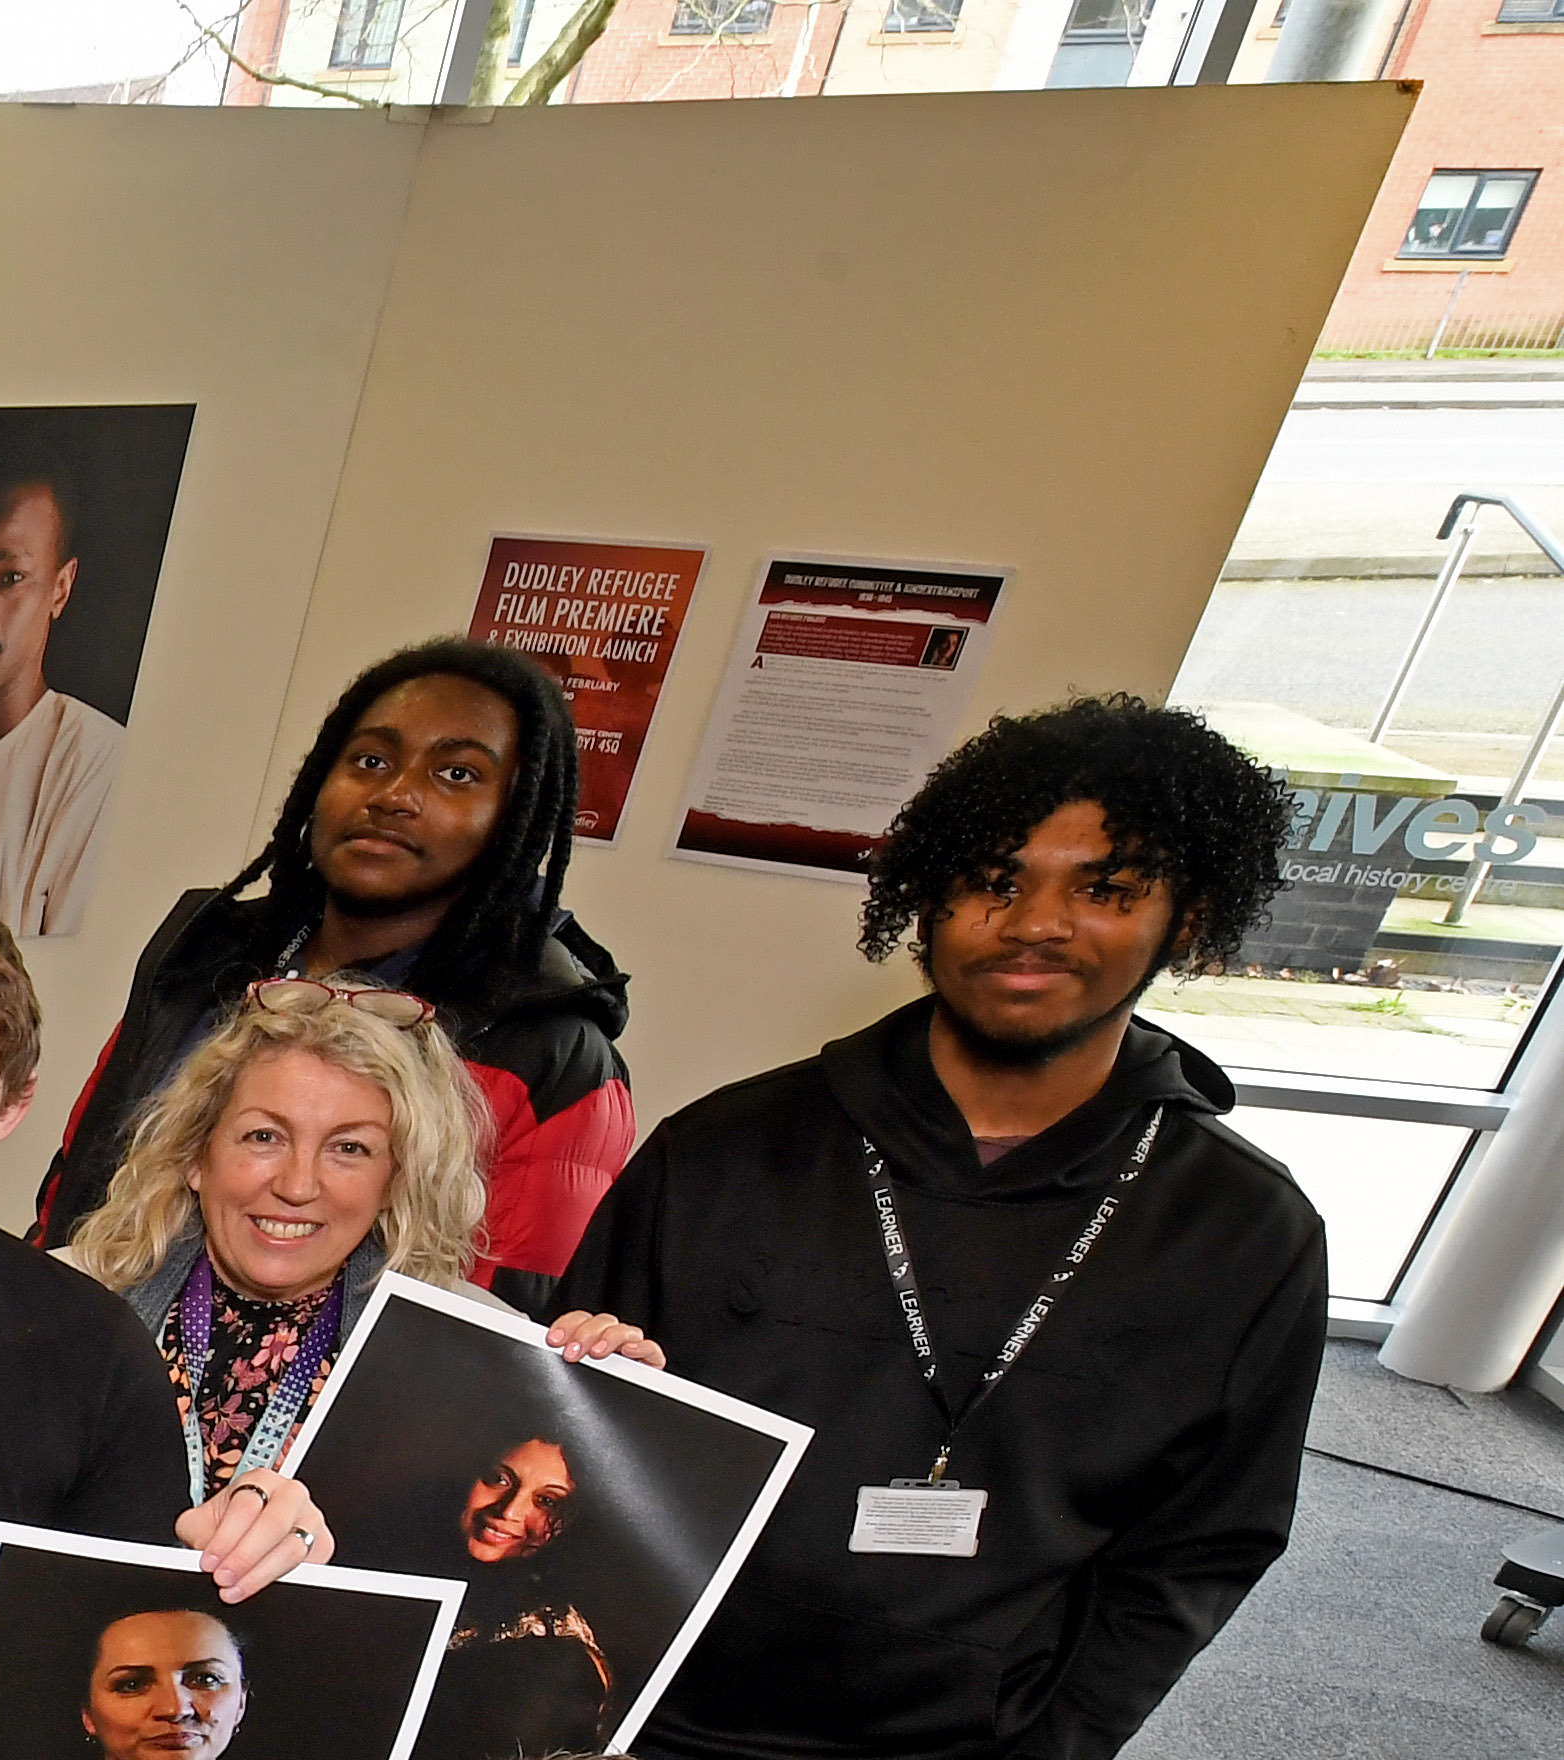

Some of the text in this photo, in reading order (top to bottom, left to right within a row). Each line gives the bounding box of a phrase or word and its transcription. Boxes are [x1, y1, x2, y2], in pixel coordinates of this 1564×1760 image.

[503, 562, 680, 600] DUDLEY REFUGEE
[494, 593, 669, 636] FILM PREMIERE
[486, 629, 659, 664] & EXHIBITION LAUNCH
[566, 677, 621, 692] FEBRUARY
[1285, 773, 1547, 865] ives
[1279, 859, 1342, 884] local
[1343, 864, 1430, 895] history
[275, 925, 310, 969] LEARNER
[874, 1188, 903, 1257] LEARNER
[1066, 1196, 1119, 1264] LEARNER
[899, 1290, 931, 1358] LEARNER
[997, 1294, 1054, 1362] LEARNER
